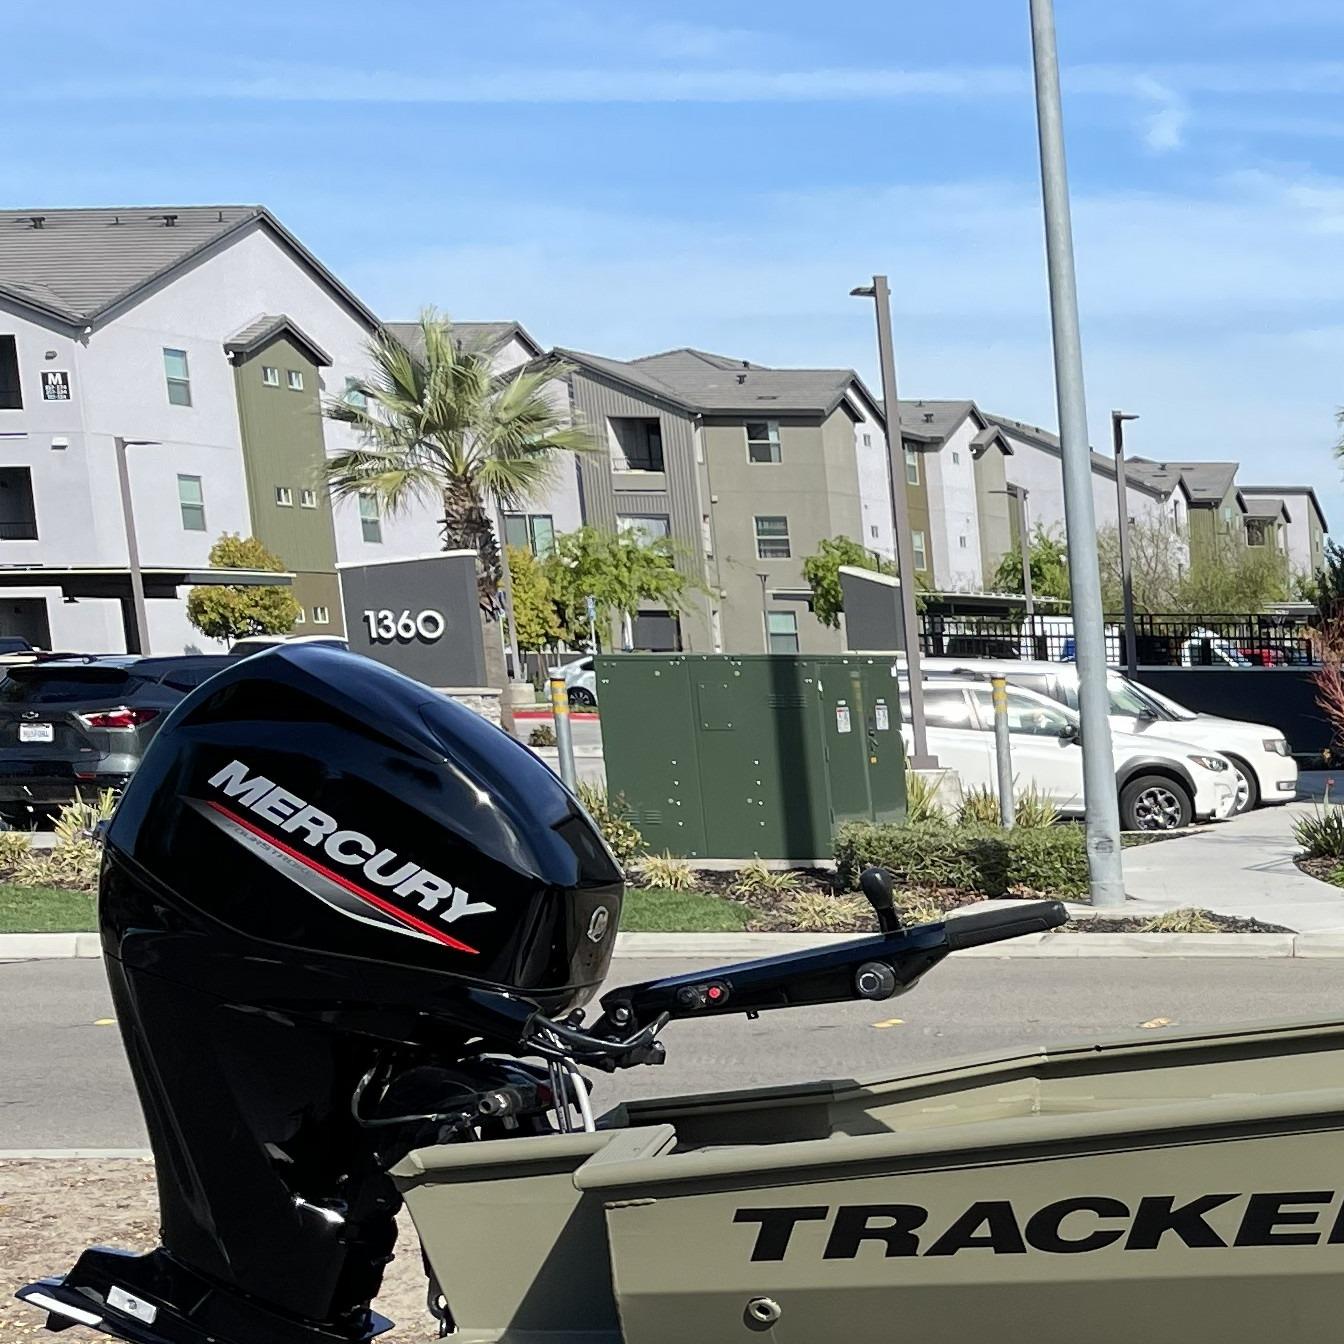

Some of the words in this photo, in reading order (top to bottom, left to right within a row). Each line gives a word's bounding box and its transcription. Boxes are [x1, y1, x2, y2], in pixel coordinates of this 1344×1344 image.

[48, 372, 62, 385] M
[364, 609, 445, 639] 1360
[208, 760, 497, 923] MERCURY
